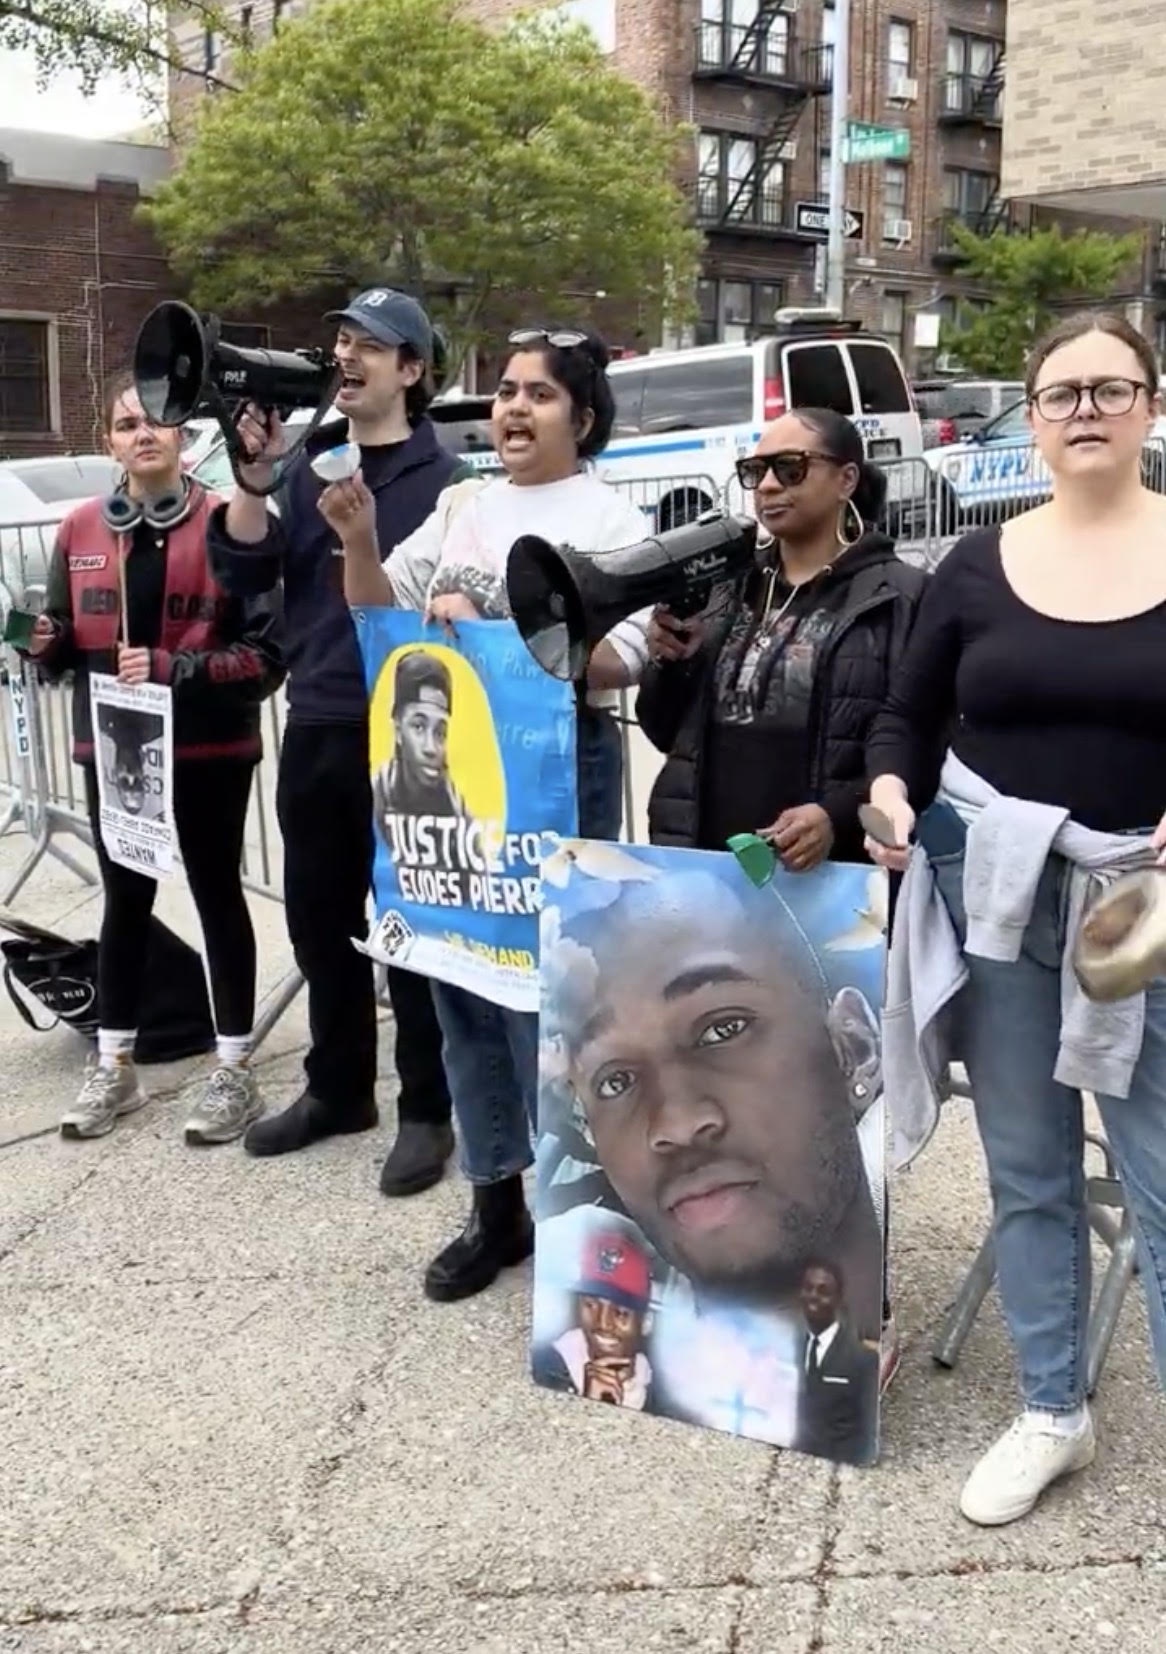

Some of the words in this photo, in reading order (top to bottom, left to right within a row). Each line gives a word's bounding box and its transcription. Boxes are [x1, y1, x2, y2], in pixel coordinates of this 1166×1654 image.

[805, 213, 826, 226] ONE
[970, 452, 1030, 483] NYPD
[11, 679, 30, 753] NYPD
[385, 814, 506, 873] JUSTICE
[399, 867, 463, 907] EUDES
[469, 874, 546, 915] PIERR
